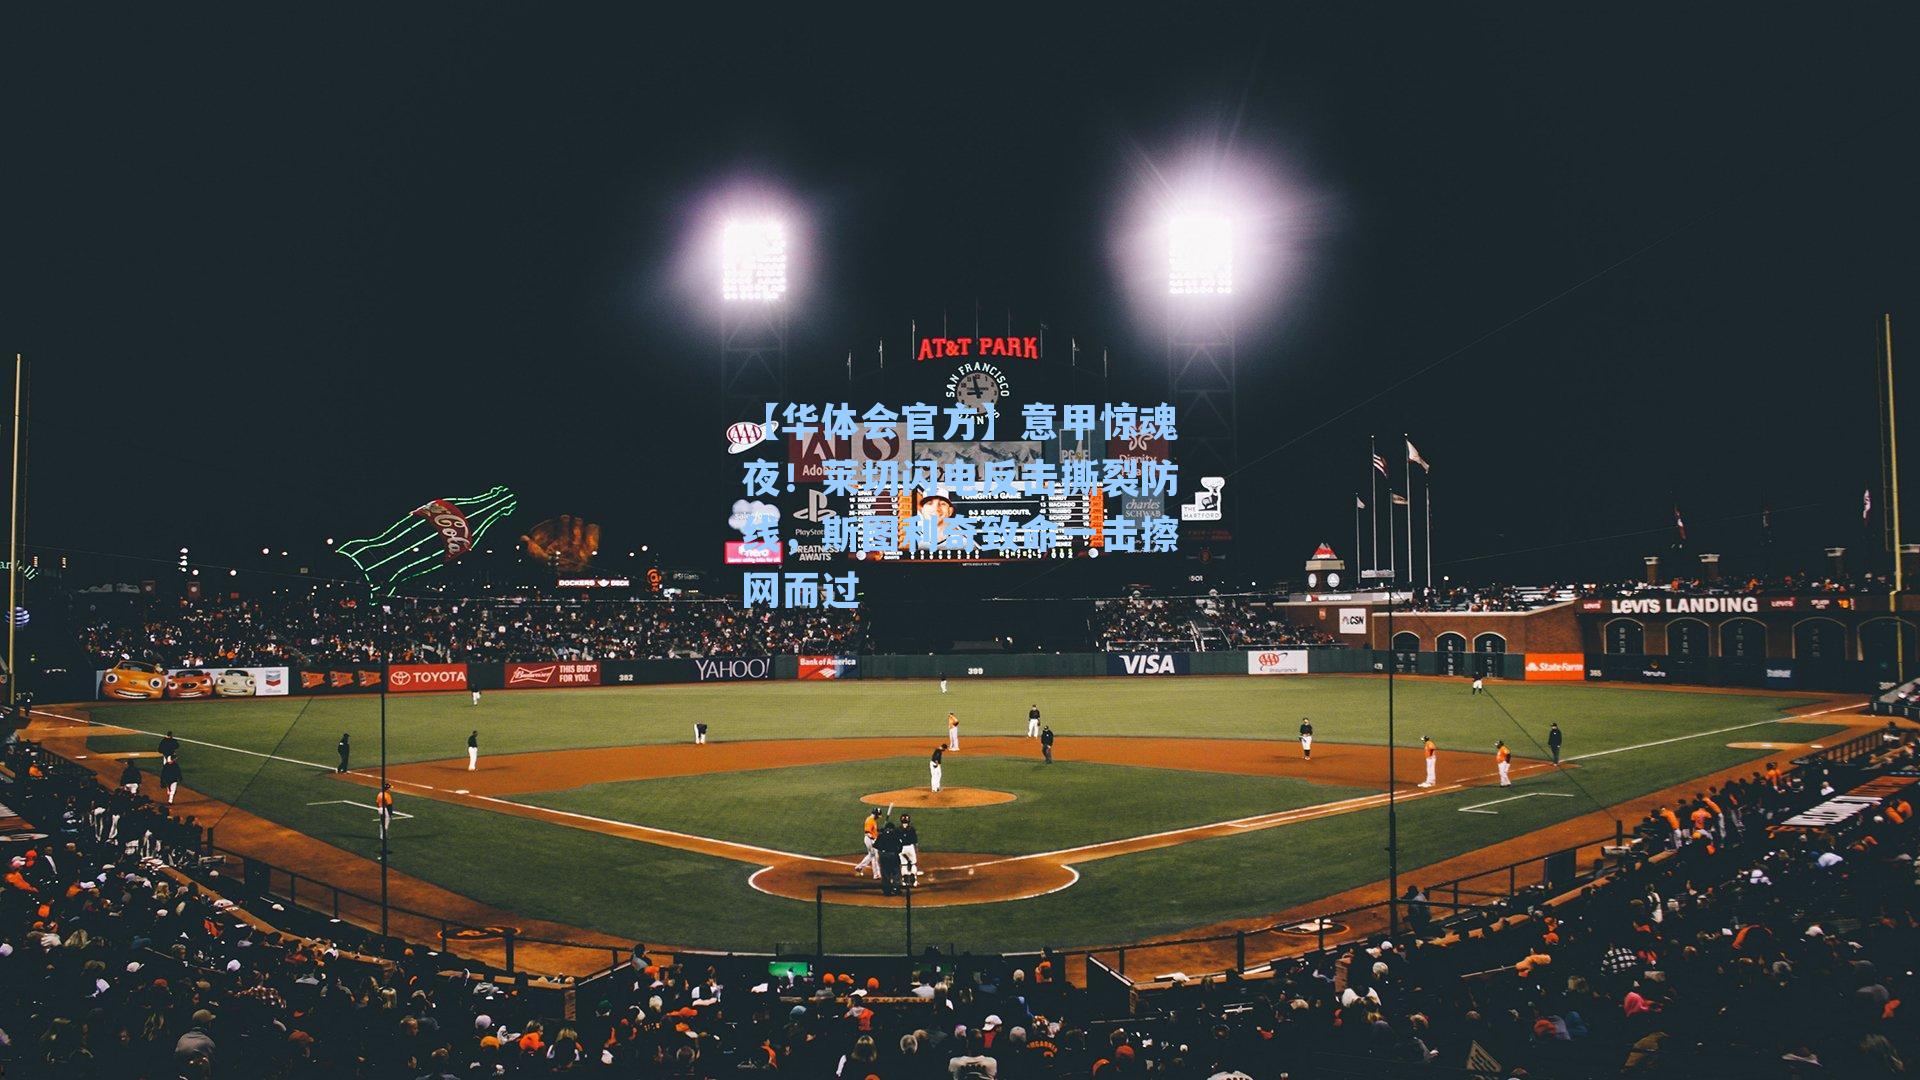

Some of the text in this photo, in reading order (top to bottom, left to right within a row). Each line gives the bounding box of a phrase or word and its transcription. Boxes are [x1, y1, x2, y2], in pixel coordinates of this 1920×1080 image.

[917, 336, 1039, 361] AT&T PARK
[946, 361, 1010, 398] SAN FRANCISCO
[799, 552, 832, 561] AWAITS
[1665, 597, 1759, 614] LANDING
[559, 664, 598, 674] THIS BUD'S
[695, 657, 771, 681] YAHOO!
[799, 657, 819, 667] Bank
[826, 657, 857, 667] America
[1119, 654, 1176, 675] VISA
[413, 670, 467, 683] TOYOTA
[559, 674, 574, 682] FOR
